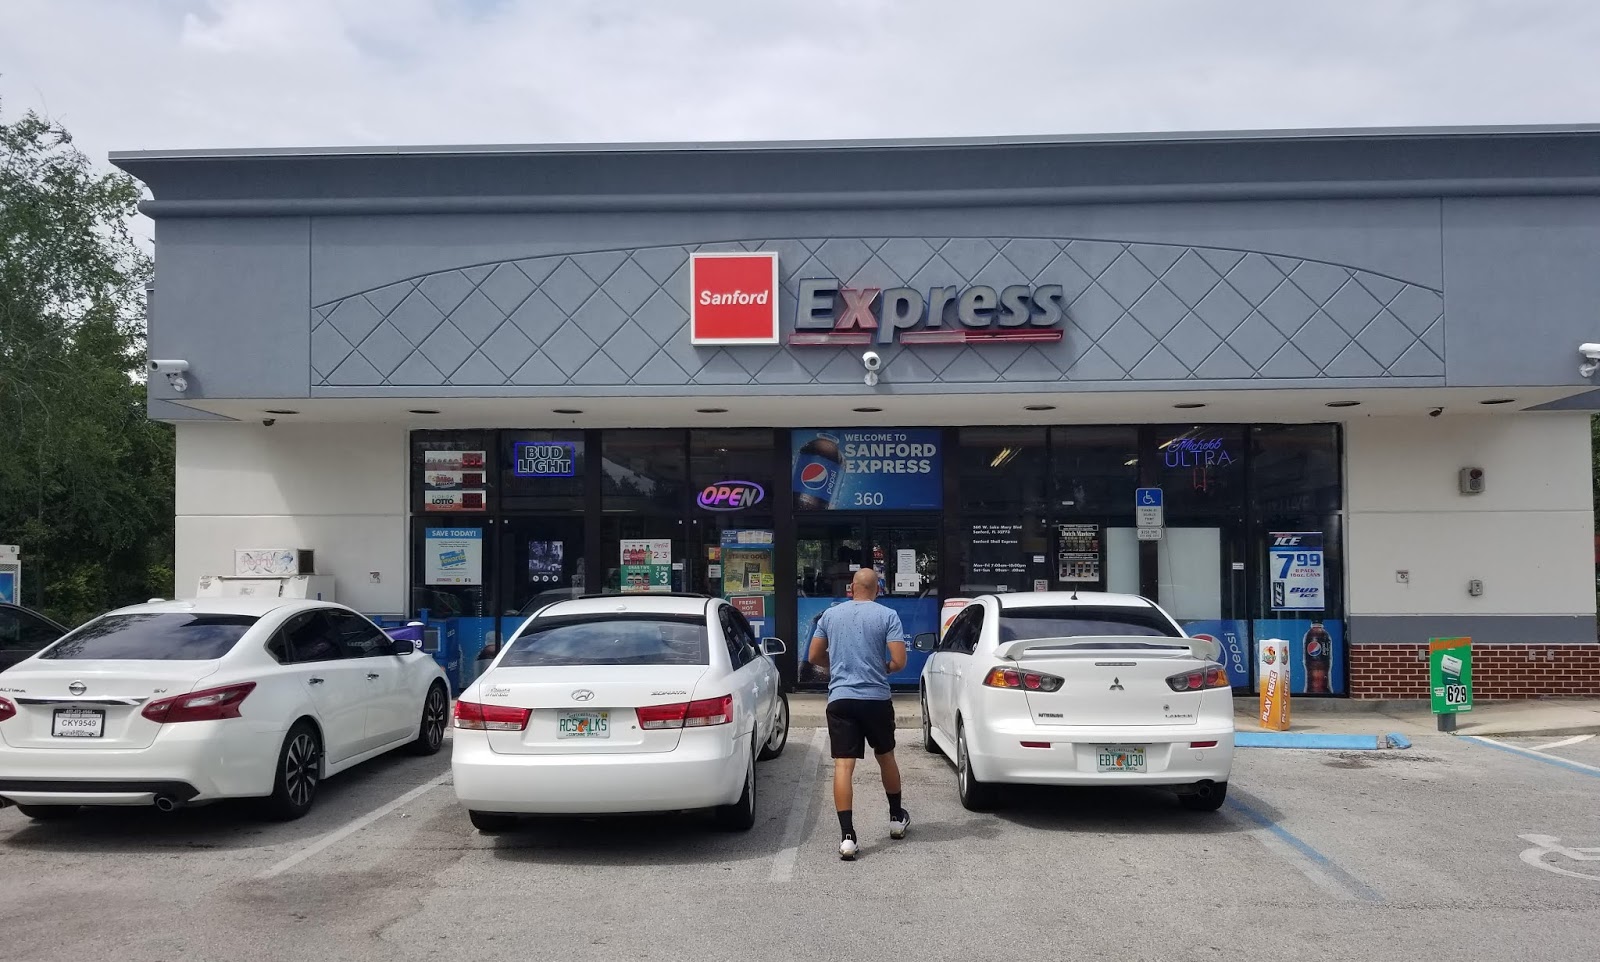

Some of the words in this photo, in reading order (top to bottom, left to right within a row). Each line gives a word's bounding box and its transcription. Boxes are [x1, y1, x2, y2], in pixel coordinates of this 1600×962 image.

[700, 290, 768, 306] Sanford
[794, 277, 1063, 344] Express
[844, 433, 892, 442] WELCOME
[894, 433, 907, 442] TO
[525, 445, 564, 460] BUD
[844, 443, 937, 458] SANFORD
[1165, 450, 1232, 467] ULTRA
[517, 459, 571, 473] LIGHT
[845, 459, 932, 474] EXPRESS
[826, 469, 837, 495] pepsi
[701, 486, 757, 507] OPEN
[854, 492, 884, 506] 360
[1273, 537, 1302, 546] ICE
[1224, 632, 1247, 674] pepsi
[1267, 669, 1278, 698] HERE
[1447, 685, 1467, 703] 629
[1262, 695, 1272, 723] PLAY
[61, 719, 97, 727] CKY9549
